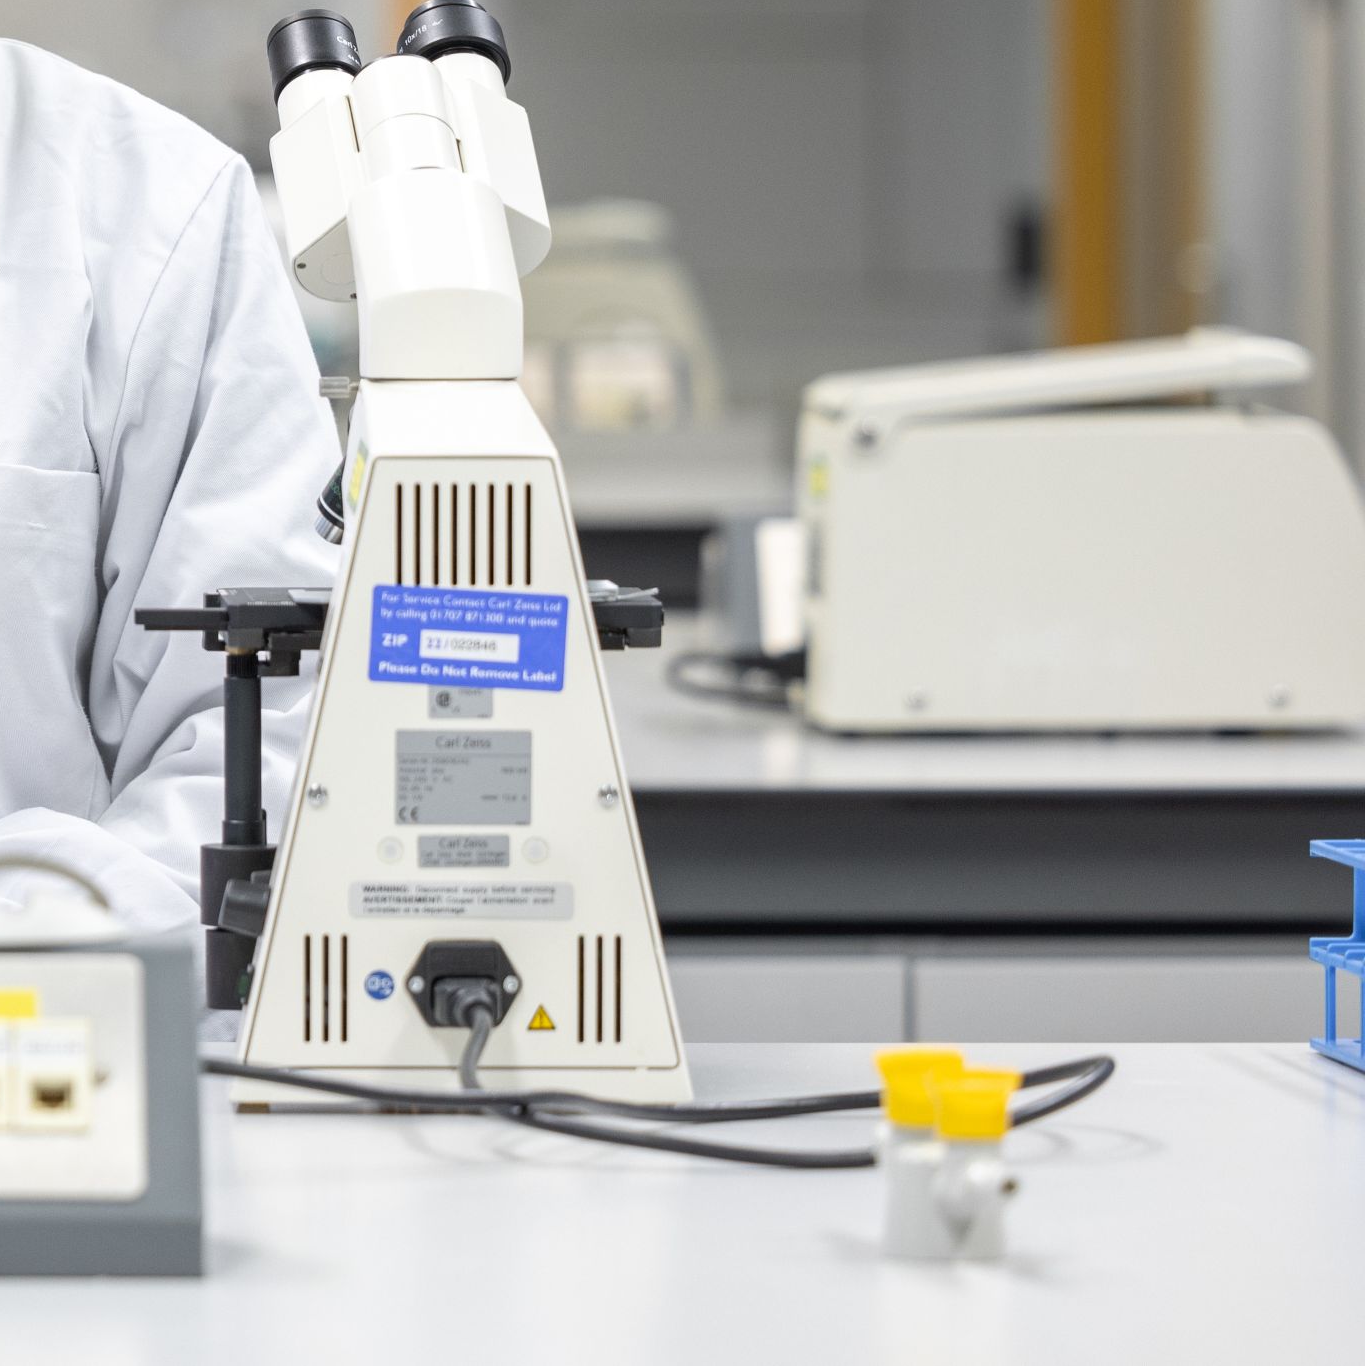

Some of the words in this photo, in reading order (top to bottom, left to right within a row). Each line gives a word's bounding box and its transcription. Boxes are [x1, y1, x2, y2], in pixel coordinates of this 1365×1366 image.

[404, 24, 427, 46] 10x/18
[381, 591, 398, 602] For
[403, 593, 440, 604] Service
[443, 595, 485, 607] Contact
[488, 596, 511, 608] Carl
[514, 599, 541, 610] Zeiss
[543, 600, 561, 612] Ltd
[395, 608, 427, 622] calling
[507, 614, 526, 625] and
[381, 633, 408, 647] ZIP
[378, 661, 418, 674] Please
[420, 663, 440, 676] Do
[442, 664, 467, 678] Not
[469, 666, 519, 681] Remove
[522, 669, 558, 682] Label
[435, 735, 460, 748] Carl
[462, 735, 492, 748] Zeiss
